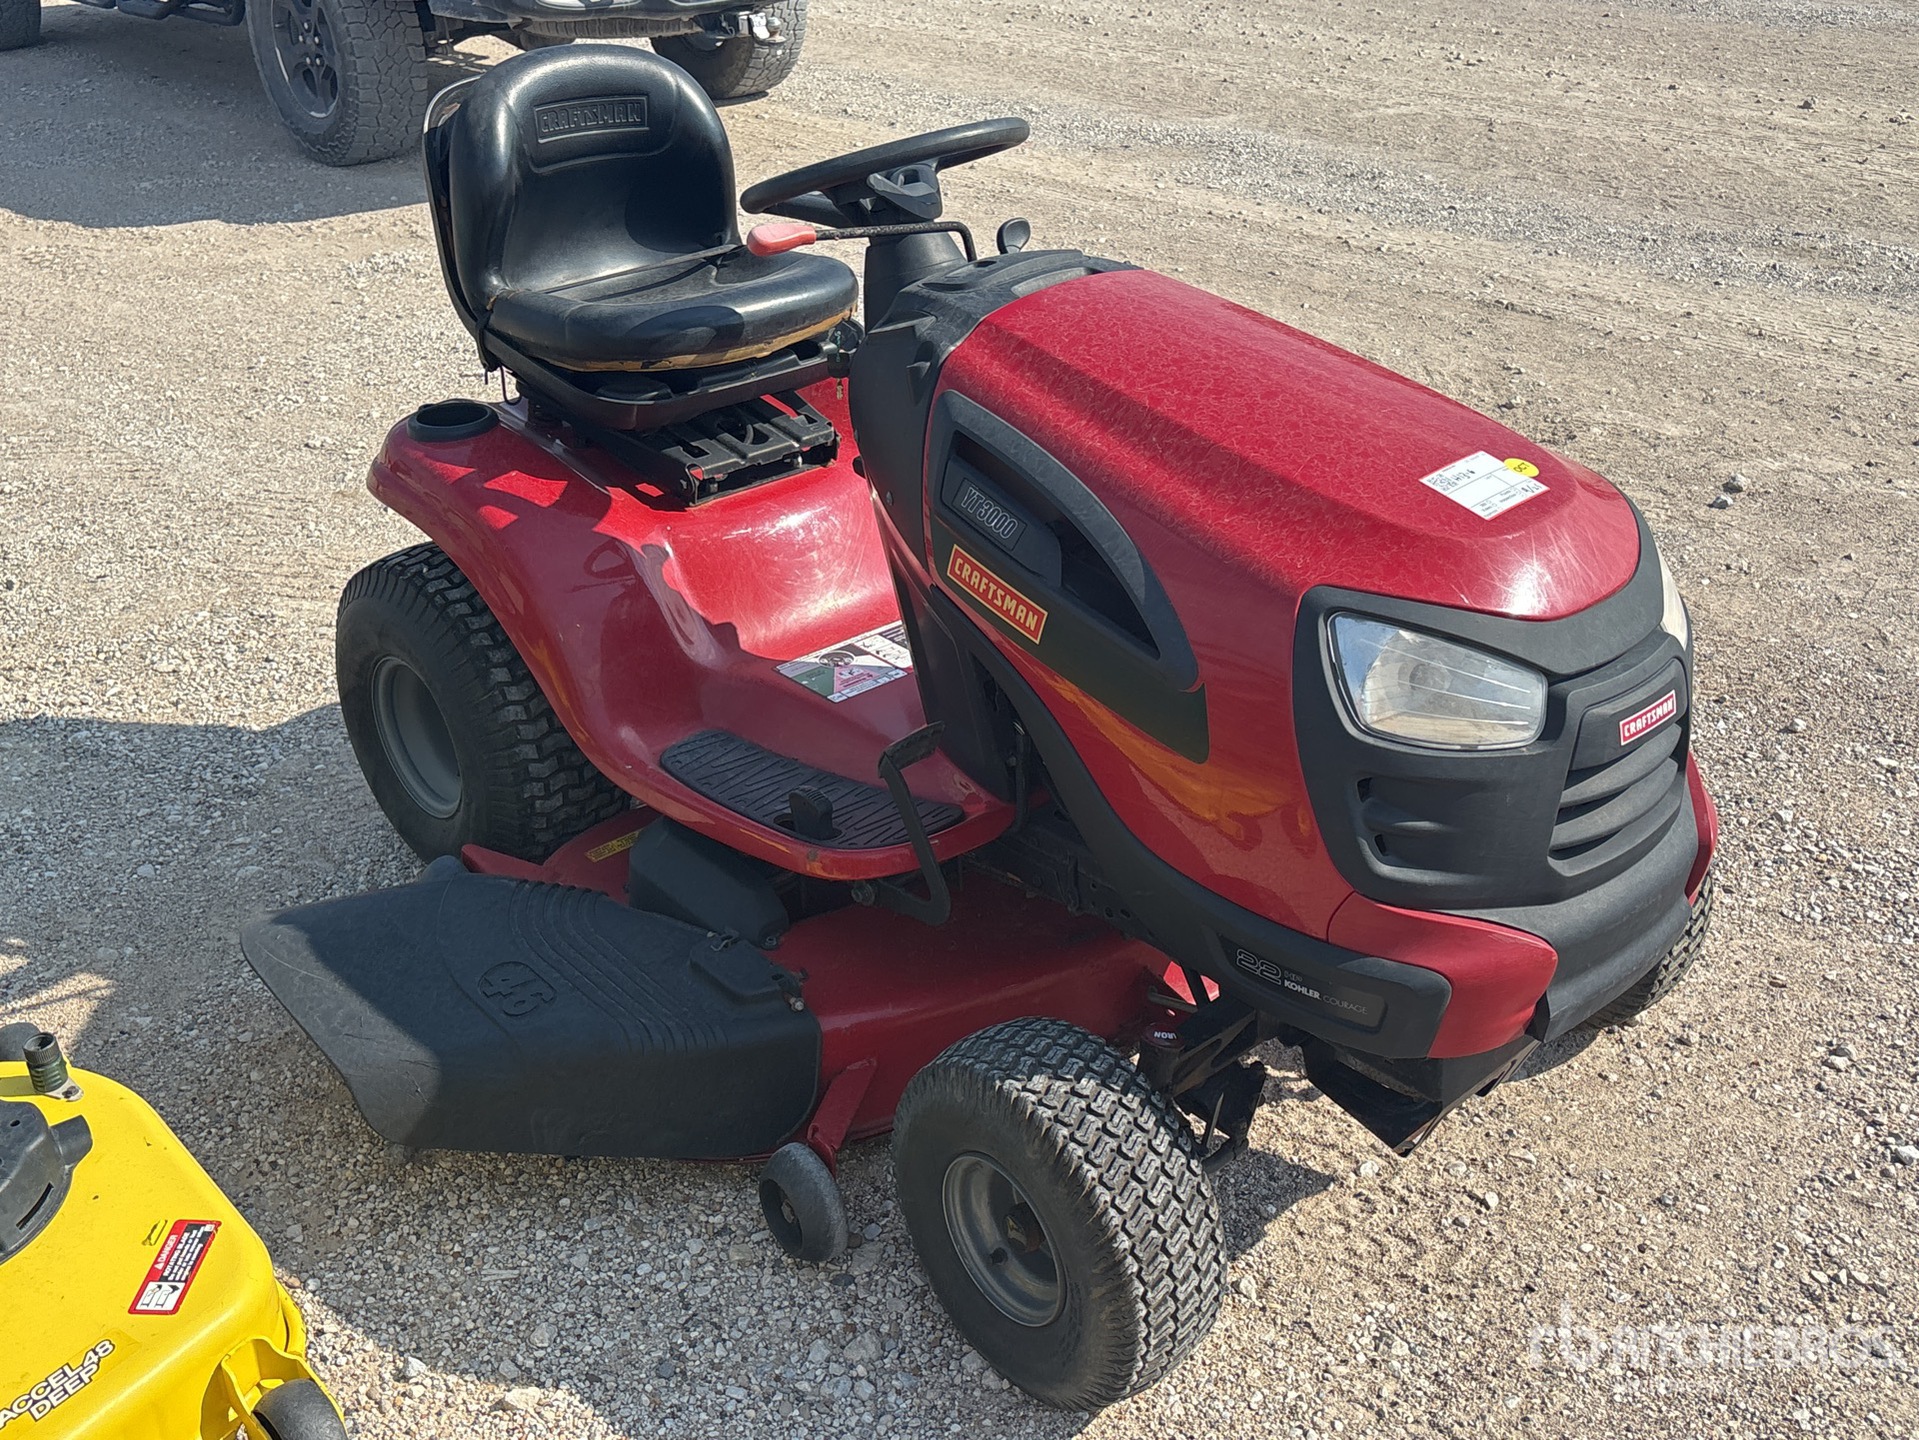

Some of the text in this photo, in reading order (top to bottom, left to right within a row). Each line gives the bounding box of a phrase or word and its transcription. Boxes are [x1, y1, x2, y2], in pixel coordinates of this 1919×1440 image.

[540, 102, 643, 132] CRAFTSMAN
[960, 485, 1019, 540] YT3000
[953, 557, 1039, 631] CRAFTSMAN
[1623, 697, 1675, 738] CRAFTSMAN
[477, 961, 557, 1017] 46
[1236, 948, 1282, 986] 22
[1284, 979, 1369, 1016] KOHLER COURAGE
[157, 1234, 179, 1263] DANGER
[0, 1362, 84, 1430] ACCEL
[28, 1362, 100, 1422] DEEP
